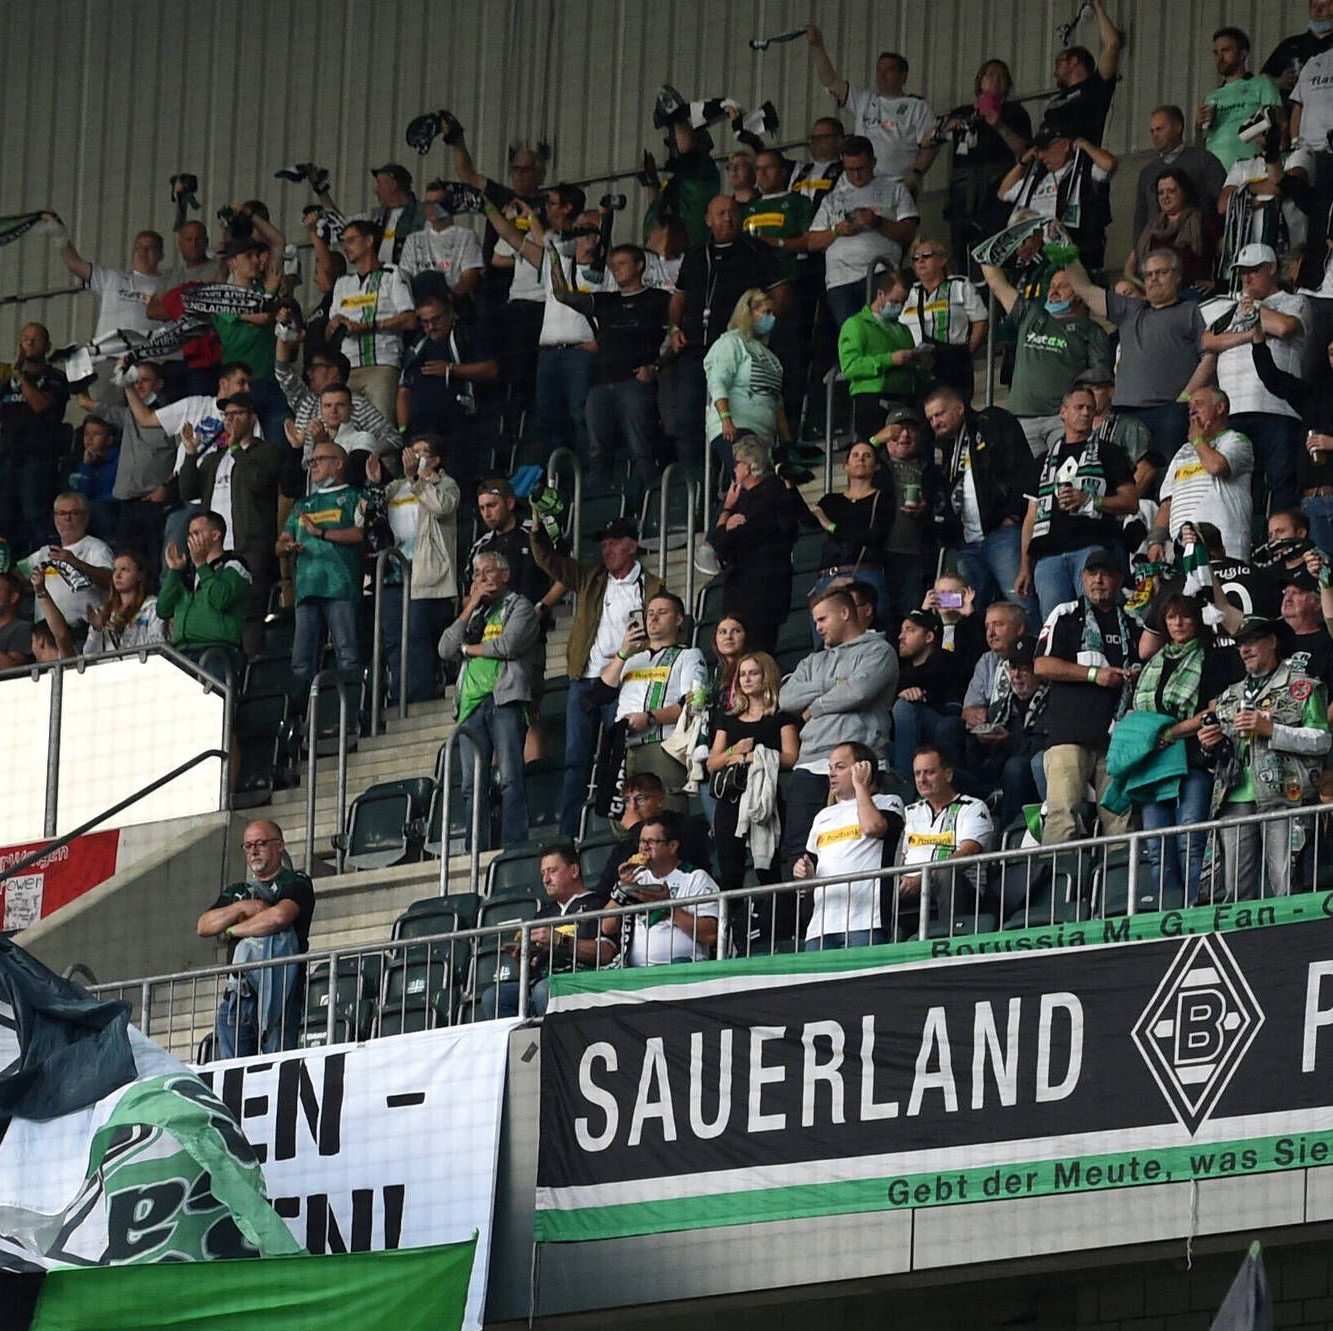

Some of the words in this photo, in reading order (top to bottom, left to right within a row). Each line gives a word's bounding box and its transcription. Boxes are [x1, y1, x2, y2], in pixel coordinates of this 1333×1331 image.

[932, 925, 1086, 958] Borussia
[1213, 904, 1276, 933] Fan
[574, 991, 1084, 1153] SAUERLAND
[888, 1175, 969, 1206] Gebt
[982, 1170, 1038, 1199] der
[1053, 1158, 1173, 1190] Meute,
[1189, 1148, 1258, 1174] was
[1274, 1136, 1329, 1166] Sie
